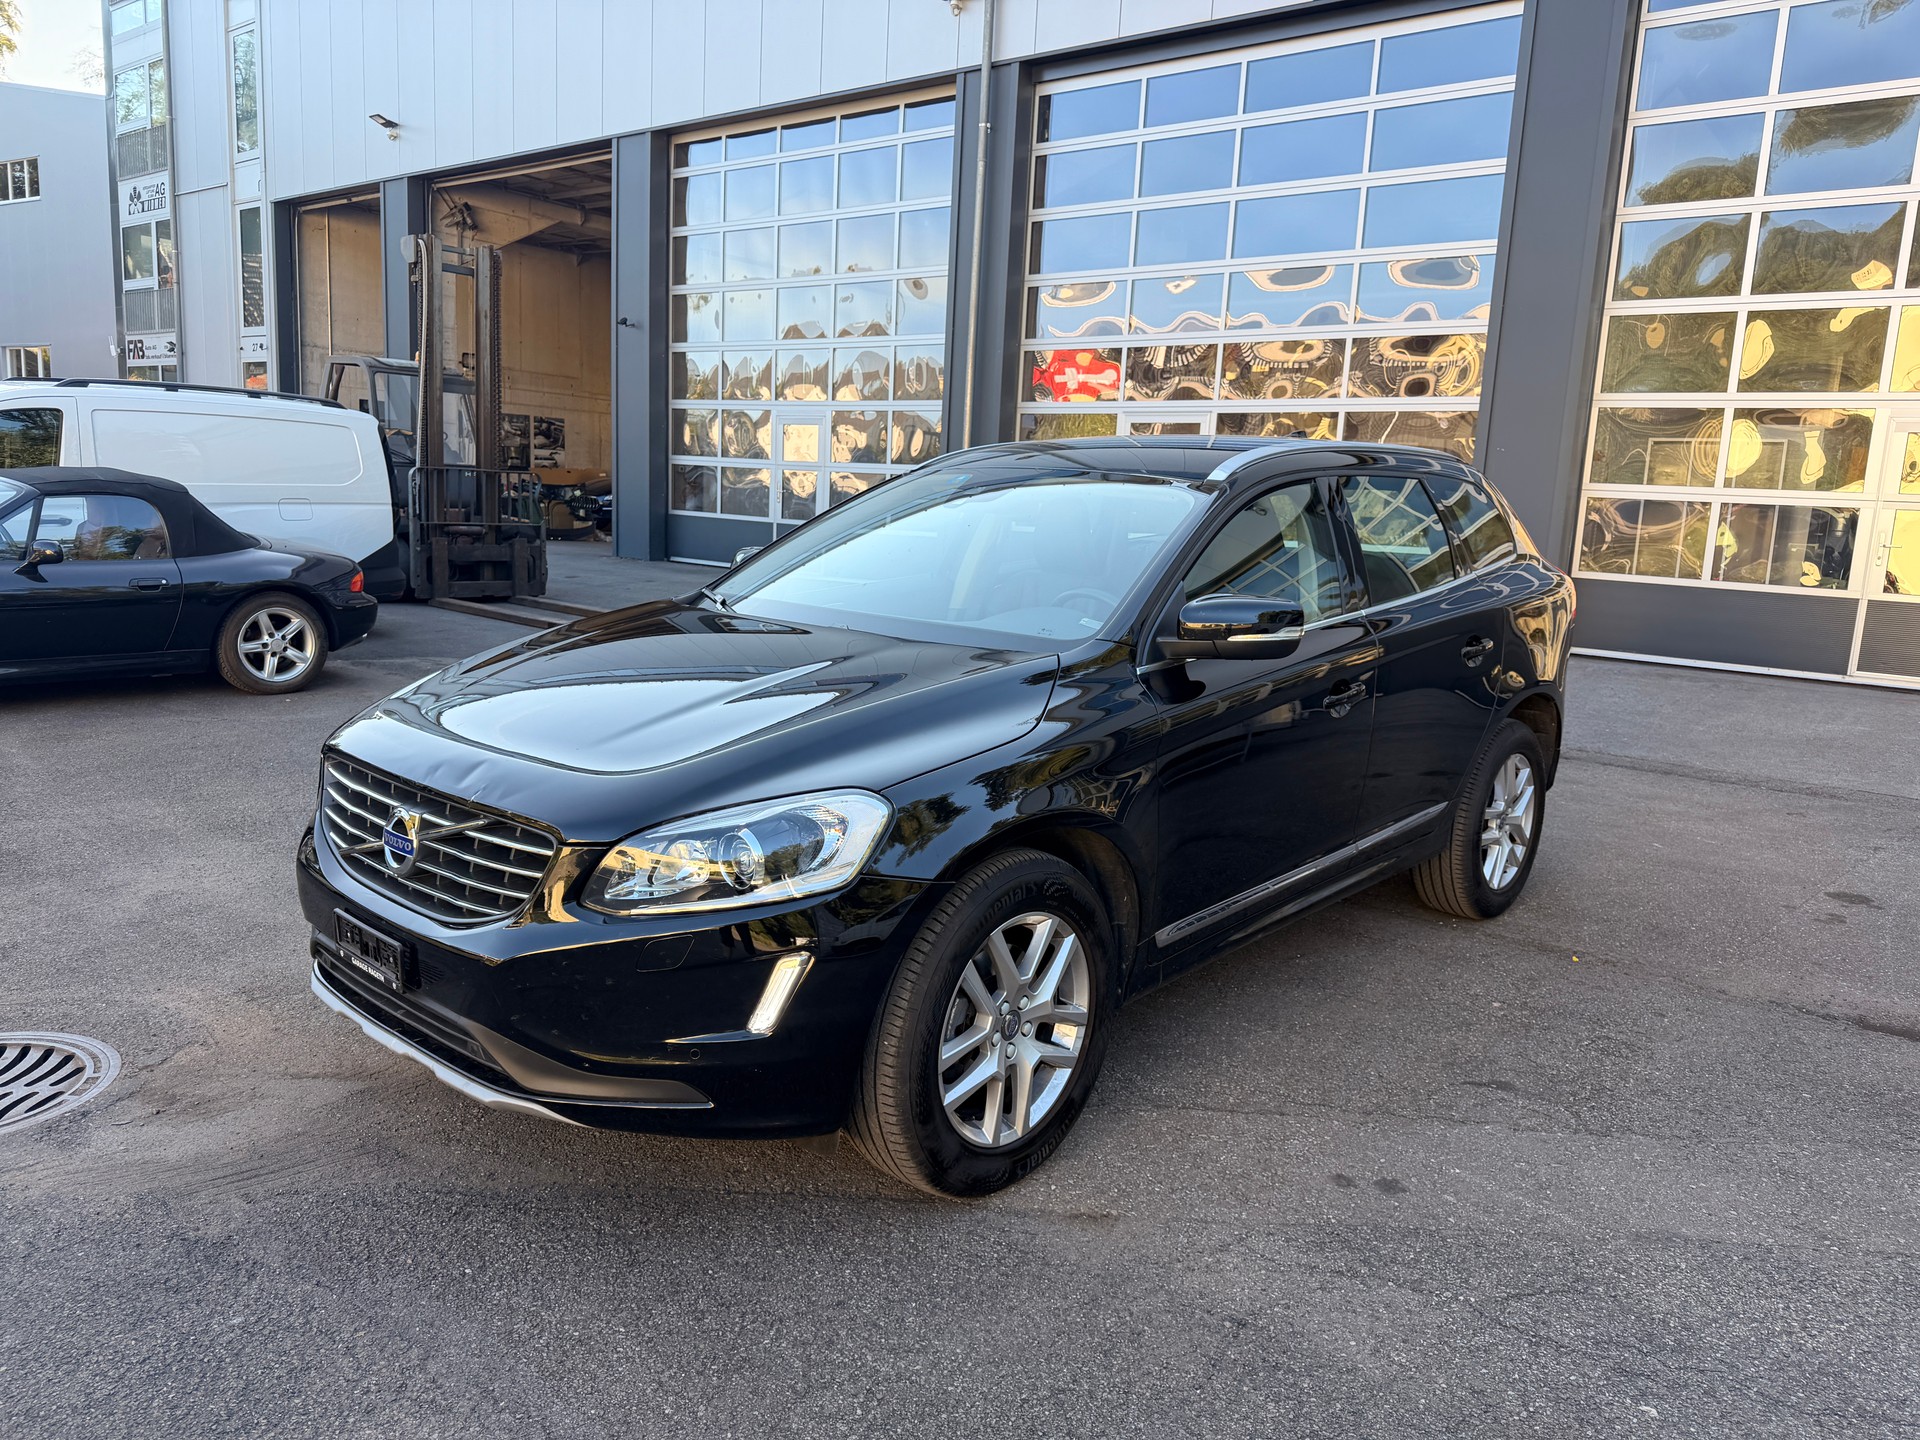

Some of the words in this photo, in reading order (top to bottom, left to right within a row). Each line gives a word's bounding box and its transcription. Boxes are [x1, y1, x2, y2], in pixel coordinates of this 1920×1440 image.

[155, 182, 166, 197] AG
[128, 339, 145, 360] FAB
[384, 832, 412, 852] VOLVO
[351, 957, 369, 973] GARAGE
